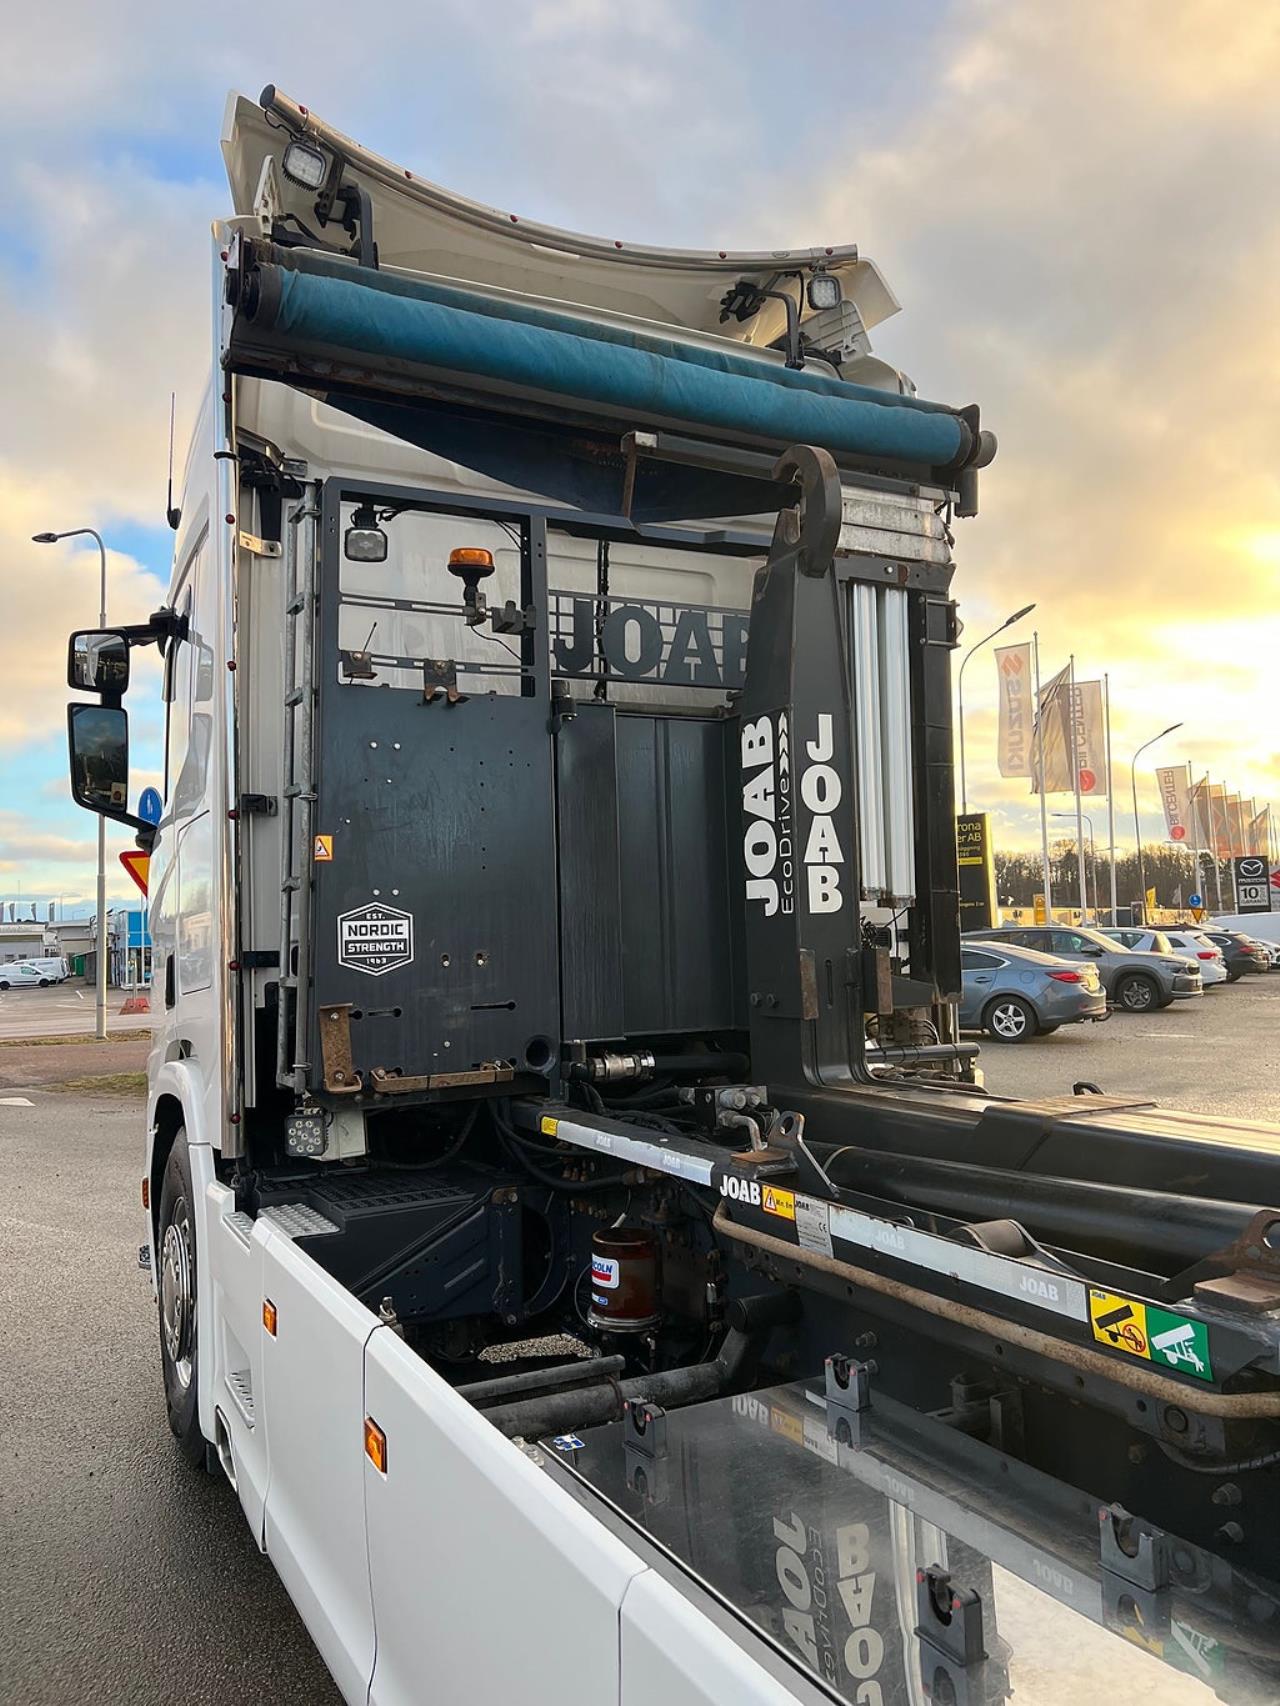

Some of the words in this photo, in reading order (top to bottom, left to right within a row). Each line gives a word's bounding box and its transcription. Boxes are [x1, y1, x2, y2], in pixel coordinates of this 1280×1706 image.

[741, 715, 780, 917] JOAB
[801, 713, 845, 914] JOAB
[779, 777, 794, 914] EcoDrive
[967, 833, 982, 842] AB
[1241, 887, 1259, 899] 10
[366, 912, 386, 920] EST.
[348, 923, 404, 937] NORDIC
[348, 941, 405, 953] STRENGTH
[719, 1174, 761, 1206] JOAB
[874, 1229, 906, 1250] JOAB
[1019, 1274, 1059, 1301] JOAB
